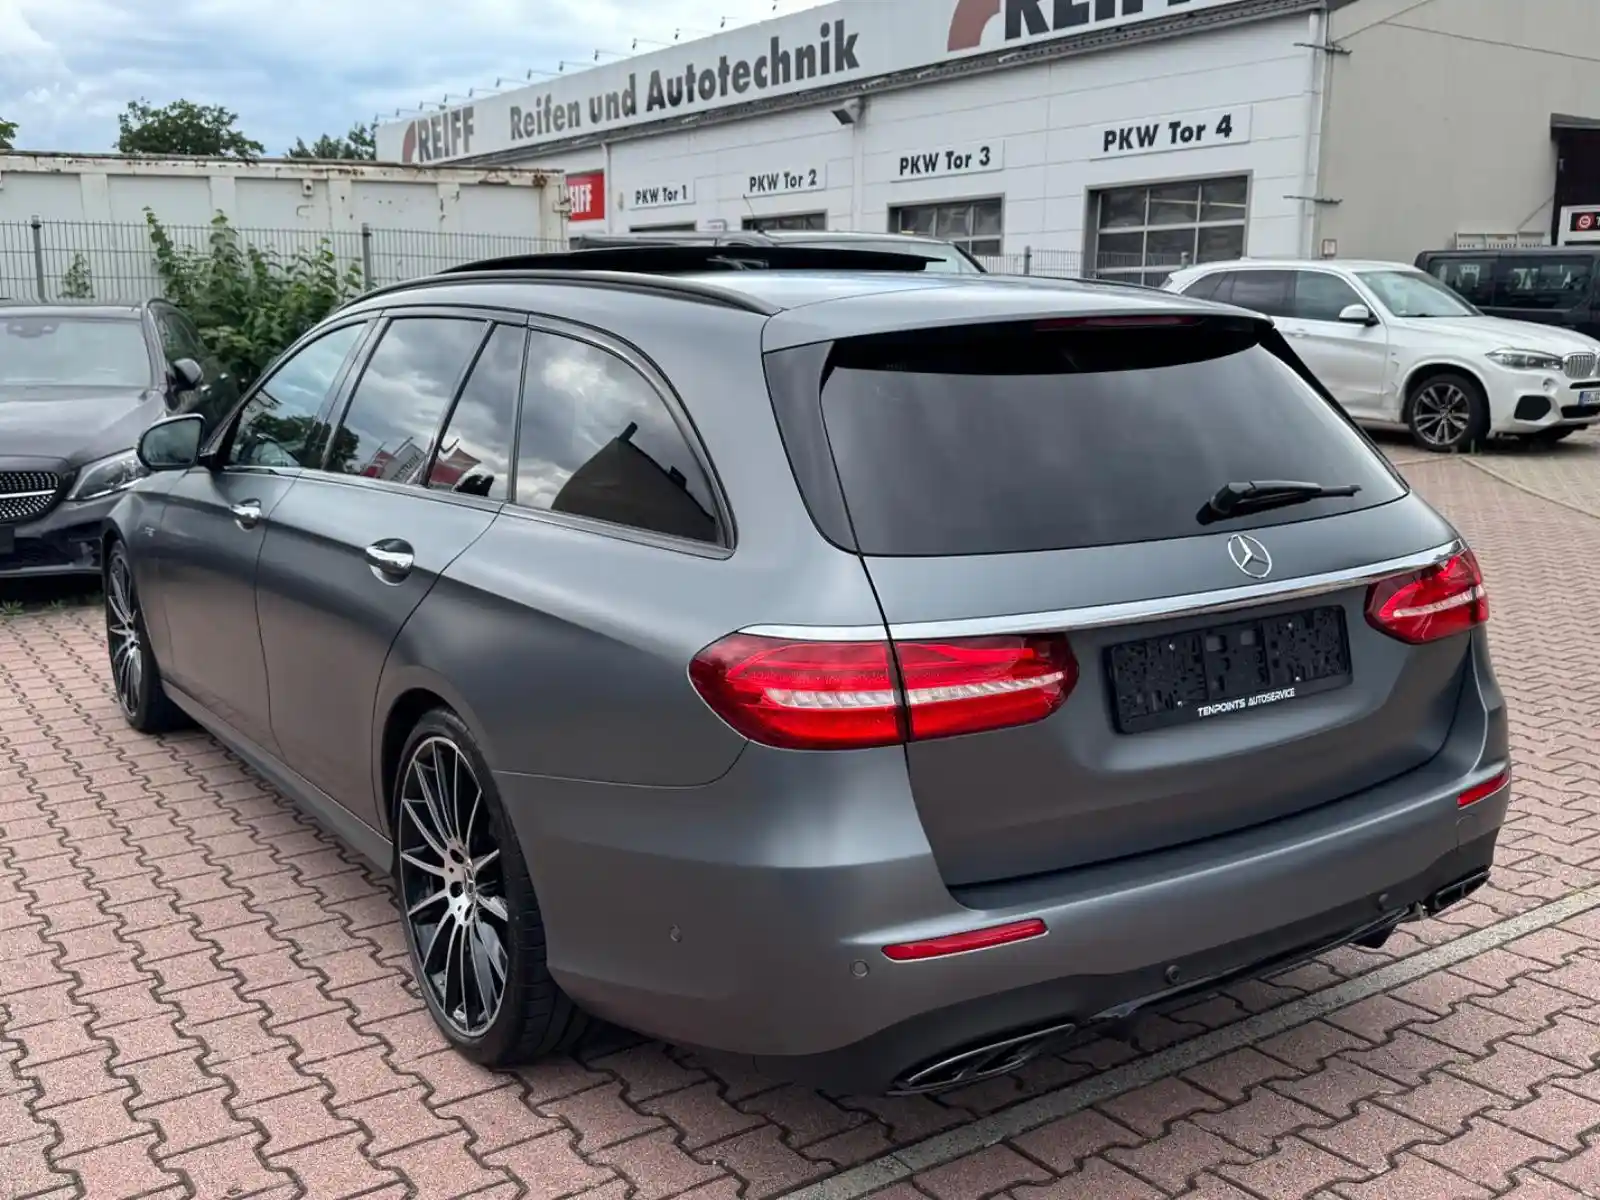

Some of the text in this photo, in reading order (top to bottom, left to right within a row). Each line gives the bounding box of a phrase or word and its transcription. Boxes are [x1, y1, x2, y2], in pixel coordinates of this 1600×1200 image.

[510, 18, 860, 141] Reifen und Autotechnik
[417, 106, 475, 164] REIFF
[1103, 113, 1233, 153] PKW Tor 4
[899, 145, 991, 176] PKW Tor 3
[635, 184, 688, 205] PKW Tor 1
[749, 168, 817, 194] PKW Tor 2
[569, 183, 593, 214] EIFF
[1197, 687, 1296, 717] TENPOINTS AUTOSERVICE
